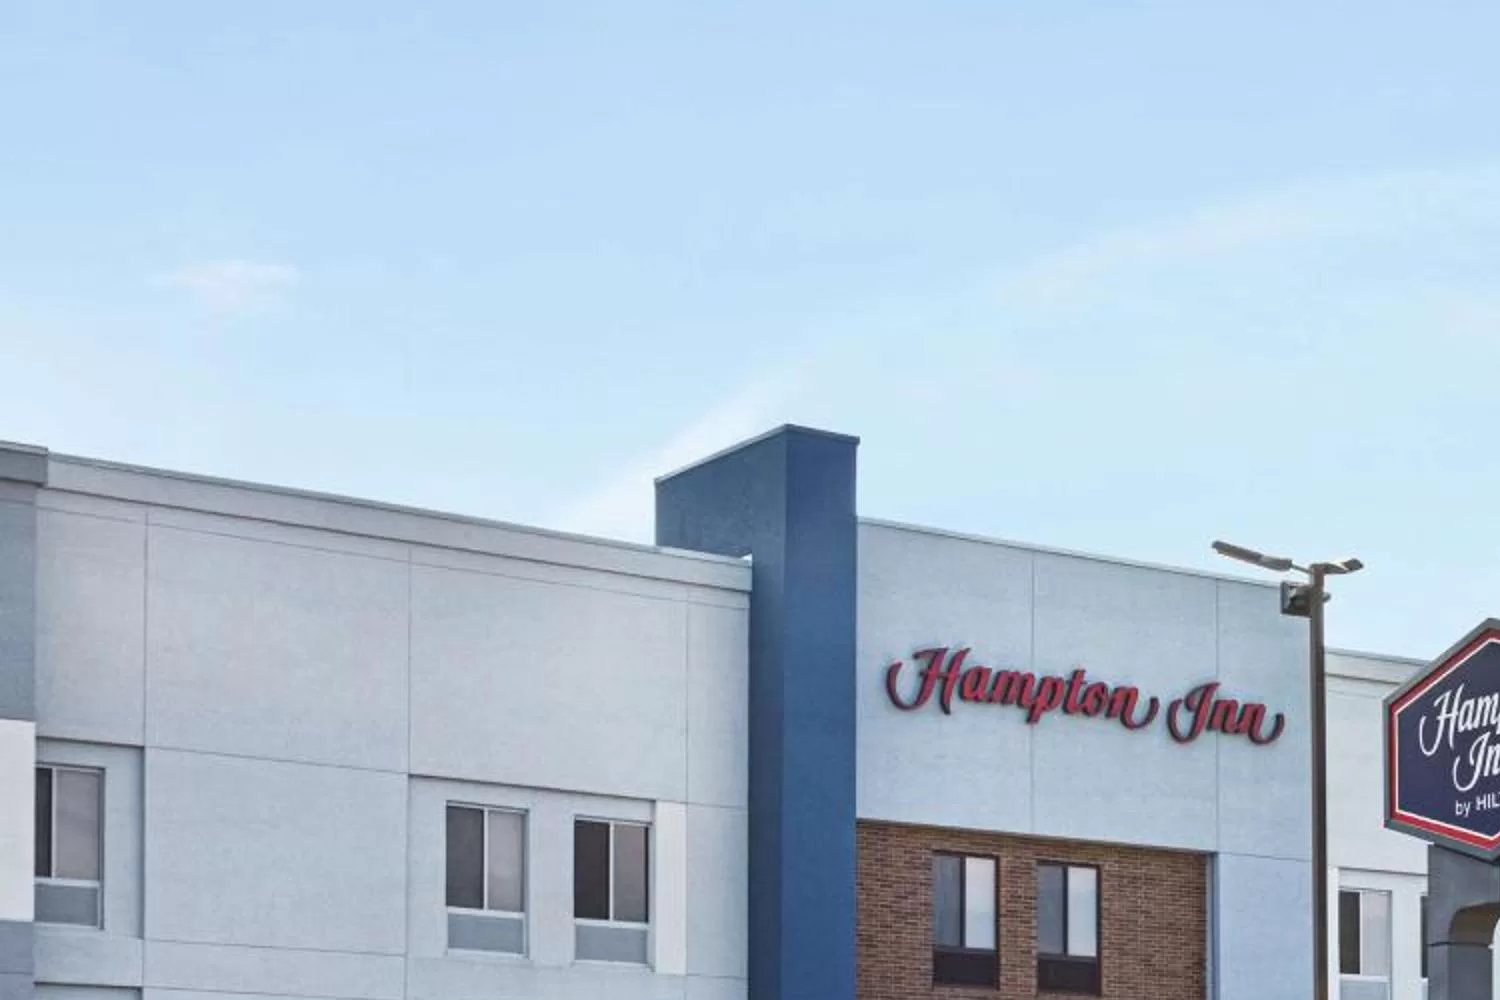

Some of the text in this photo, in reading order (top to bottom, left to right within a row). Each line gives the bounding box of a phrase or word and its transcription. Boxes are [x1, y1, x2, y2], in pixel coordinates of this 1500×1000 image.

[885, 647, 1285, 744] Hampton Inn
[1455, 800, 1471, 817] by
